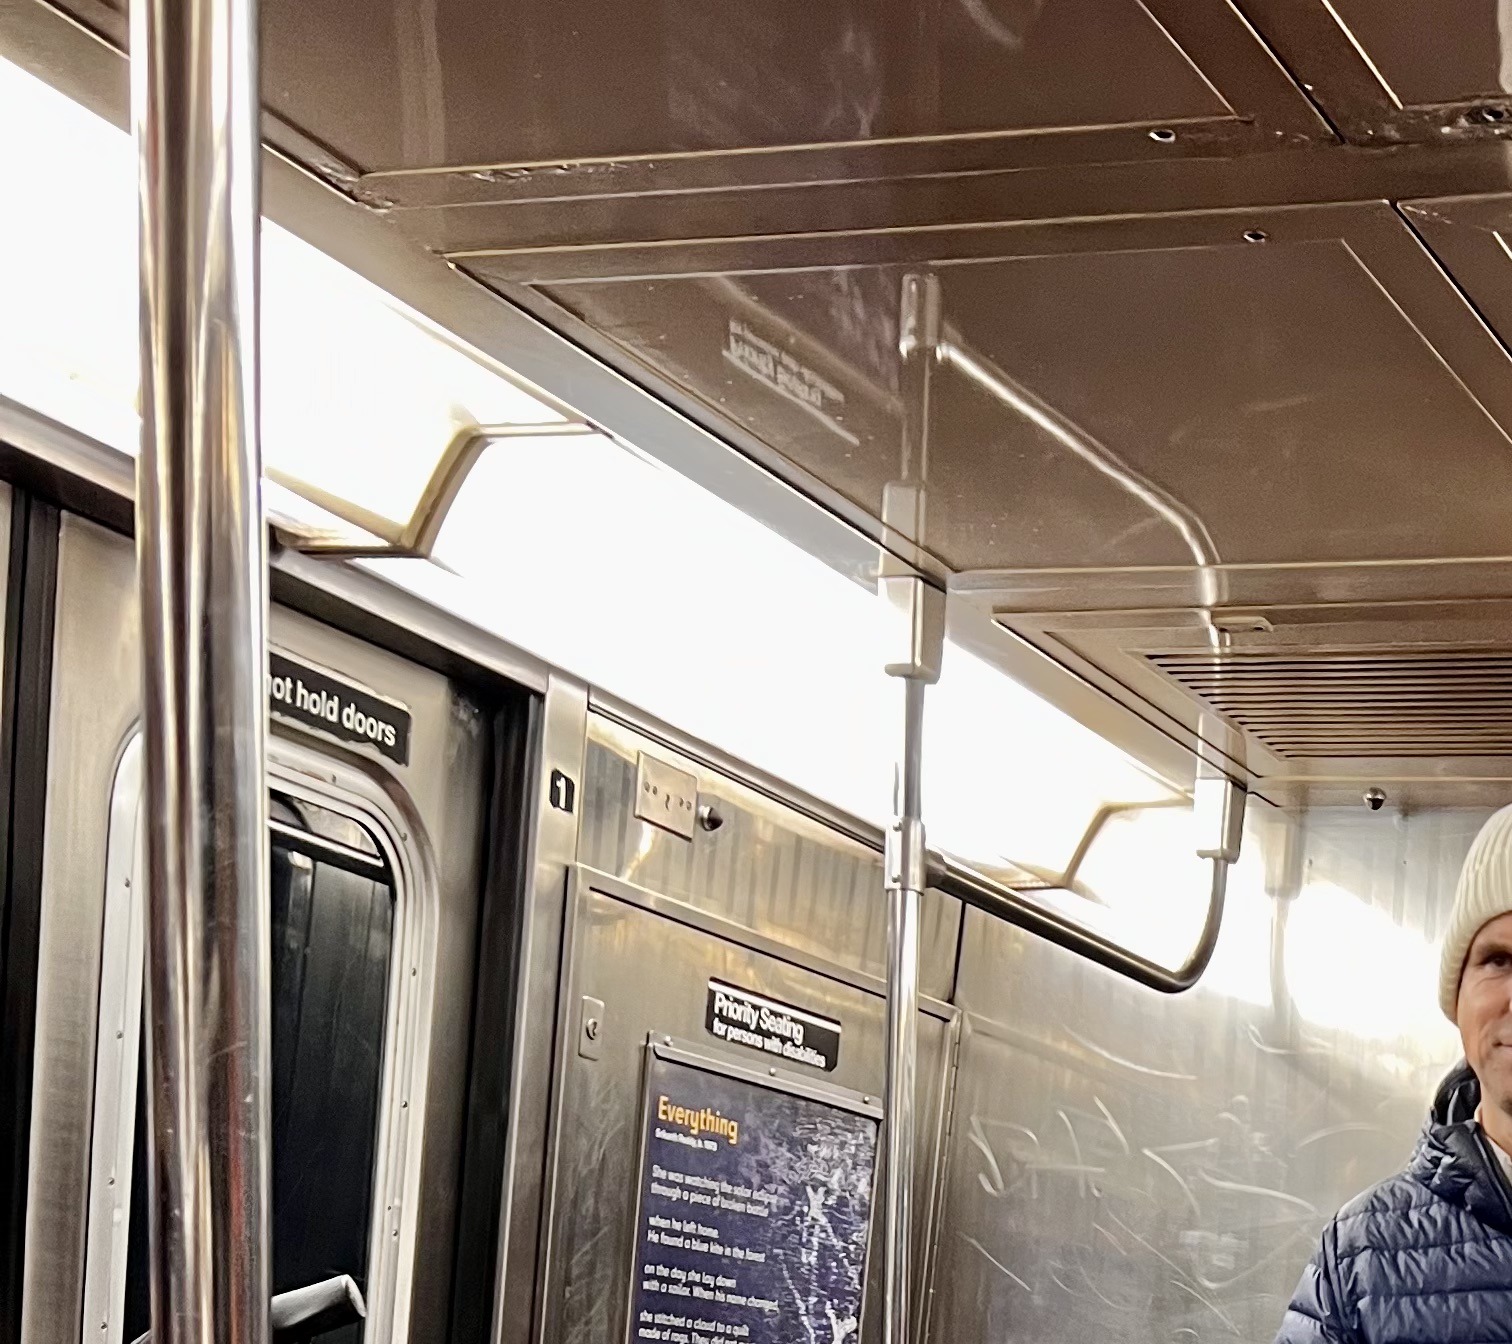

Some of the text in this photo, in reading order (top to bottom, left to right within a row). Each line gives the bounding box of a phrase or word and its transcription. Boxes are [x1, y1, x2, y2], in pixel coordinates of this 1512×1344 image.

[296, 679, 340, 724] hold
[342, 702, 396, 747] doors
[555, 776, 567, 809] 1
[714, 991, 804, 1046] Priority Seating
[712, 1017, 826, 1068] for persons with disabilities
[658, 1095, 738, 1144] Everything
[652, 1164, 667, 1179] She
[651, 1182, 681, 1201] through
[682, 1190, 689, 1200] a
[671, 1218, 682, 1231] he
[682, 1220, 696, 1233] left
[647, 1229, 659, 1243] He
[660, 1231, 684, 1247] found
[684, 1239, 691, 1249] a
[691, 1238, 709, 1252] blue
[644, 1264, 737, 1288] on the day she lay down
[643, 1280, 659, 1291] with
[661, 1283, 668, 1293] a
[692, 1285, 715, 1300] When
[715, 1289, 726, 1302] his
[638, 1327, 660, 1340] made
[661, 1328, 671, 1341] of
[640, 1310, 653, 1323] she
[686, 1318, 693, 1328] a
[693, 1318, 716, 1332] cloud
[717, 1322, 725, 1333] to
[726, 1324, 732, 1334] a
